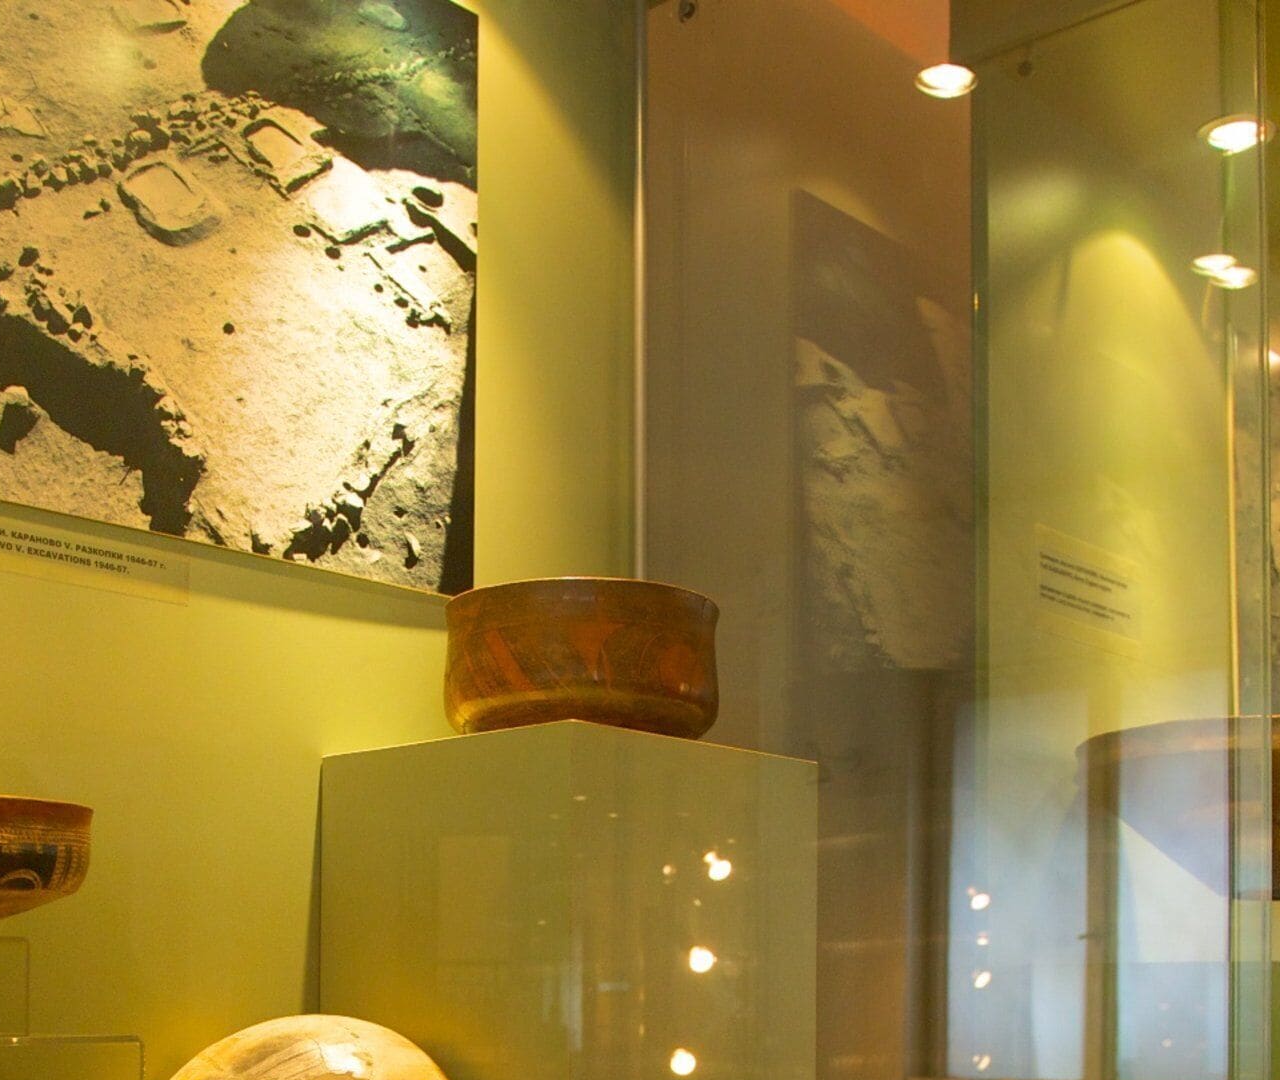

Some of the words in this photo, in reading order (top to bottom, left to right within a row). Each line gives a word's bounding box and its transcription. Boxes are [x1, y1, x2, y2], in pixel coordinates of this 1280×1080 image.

[11, 530, 62, 548] КАРАНОВО
[64, 542, 73, 550] V.
[75, 544, 123, 560] РАЗКОПКИ
[15, 545, 24, 553] V.
[27, 547, 91, 566] EXCAVATIONS
